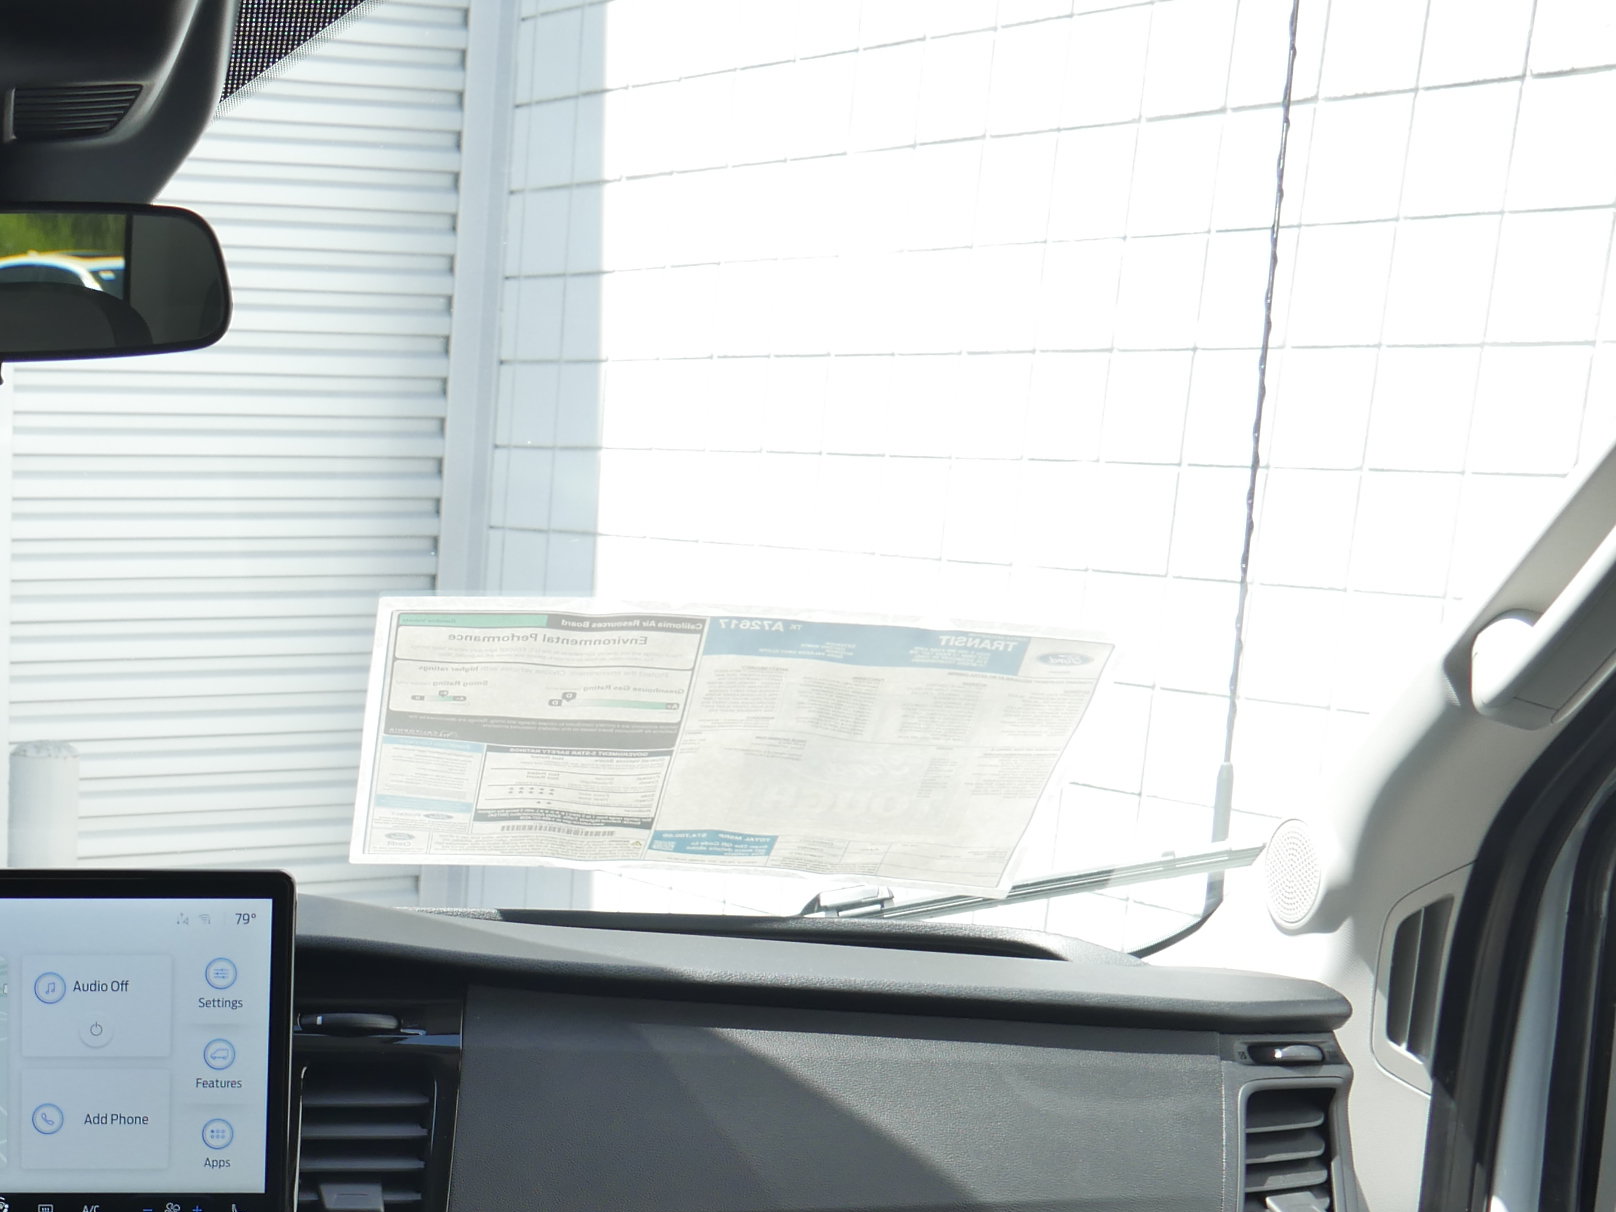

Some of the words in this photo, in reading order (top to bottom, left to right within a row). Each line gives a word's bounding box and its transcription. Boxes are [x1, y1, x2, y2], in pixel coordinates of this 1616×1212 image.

[235, 912, 256, 925] 79°
[72, 980, 108, 993] Audio
[110, 980, 129, 993] Off
[198, 997, 243, 1010] Settings
[195, 1078, 242, 1089] Features
[84, 1113, 108, 1125] Add
[110, 1113, 149, 1125] Phone
[204, 1157, 231, 1169] Apps
